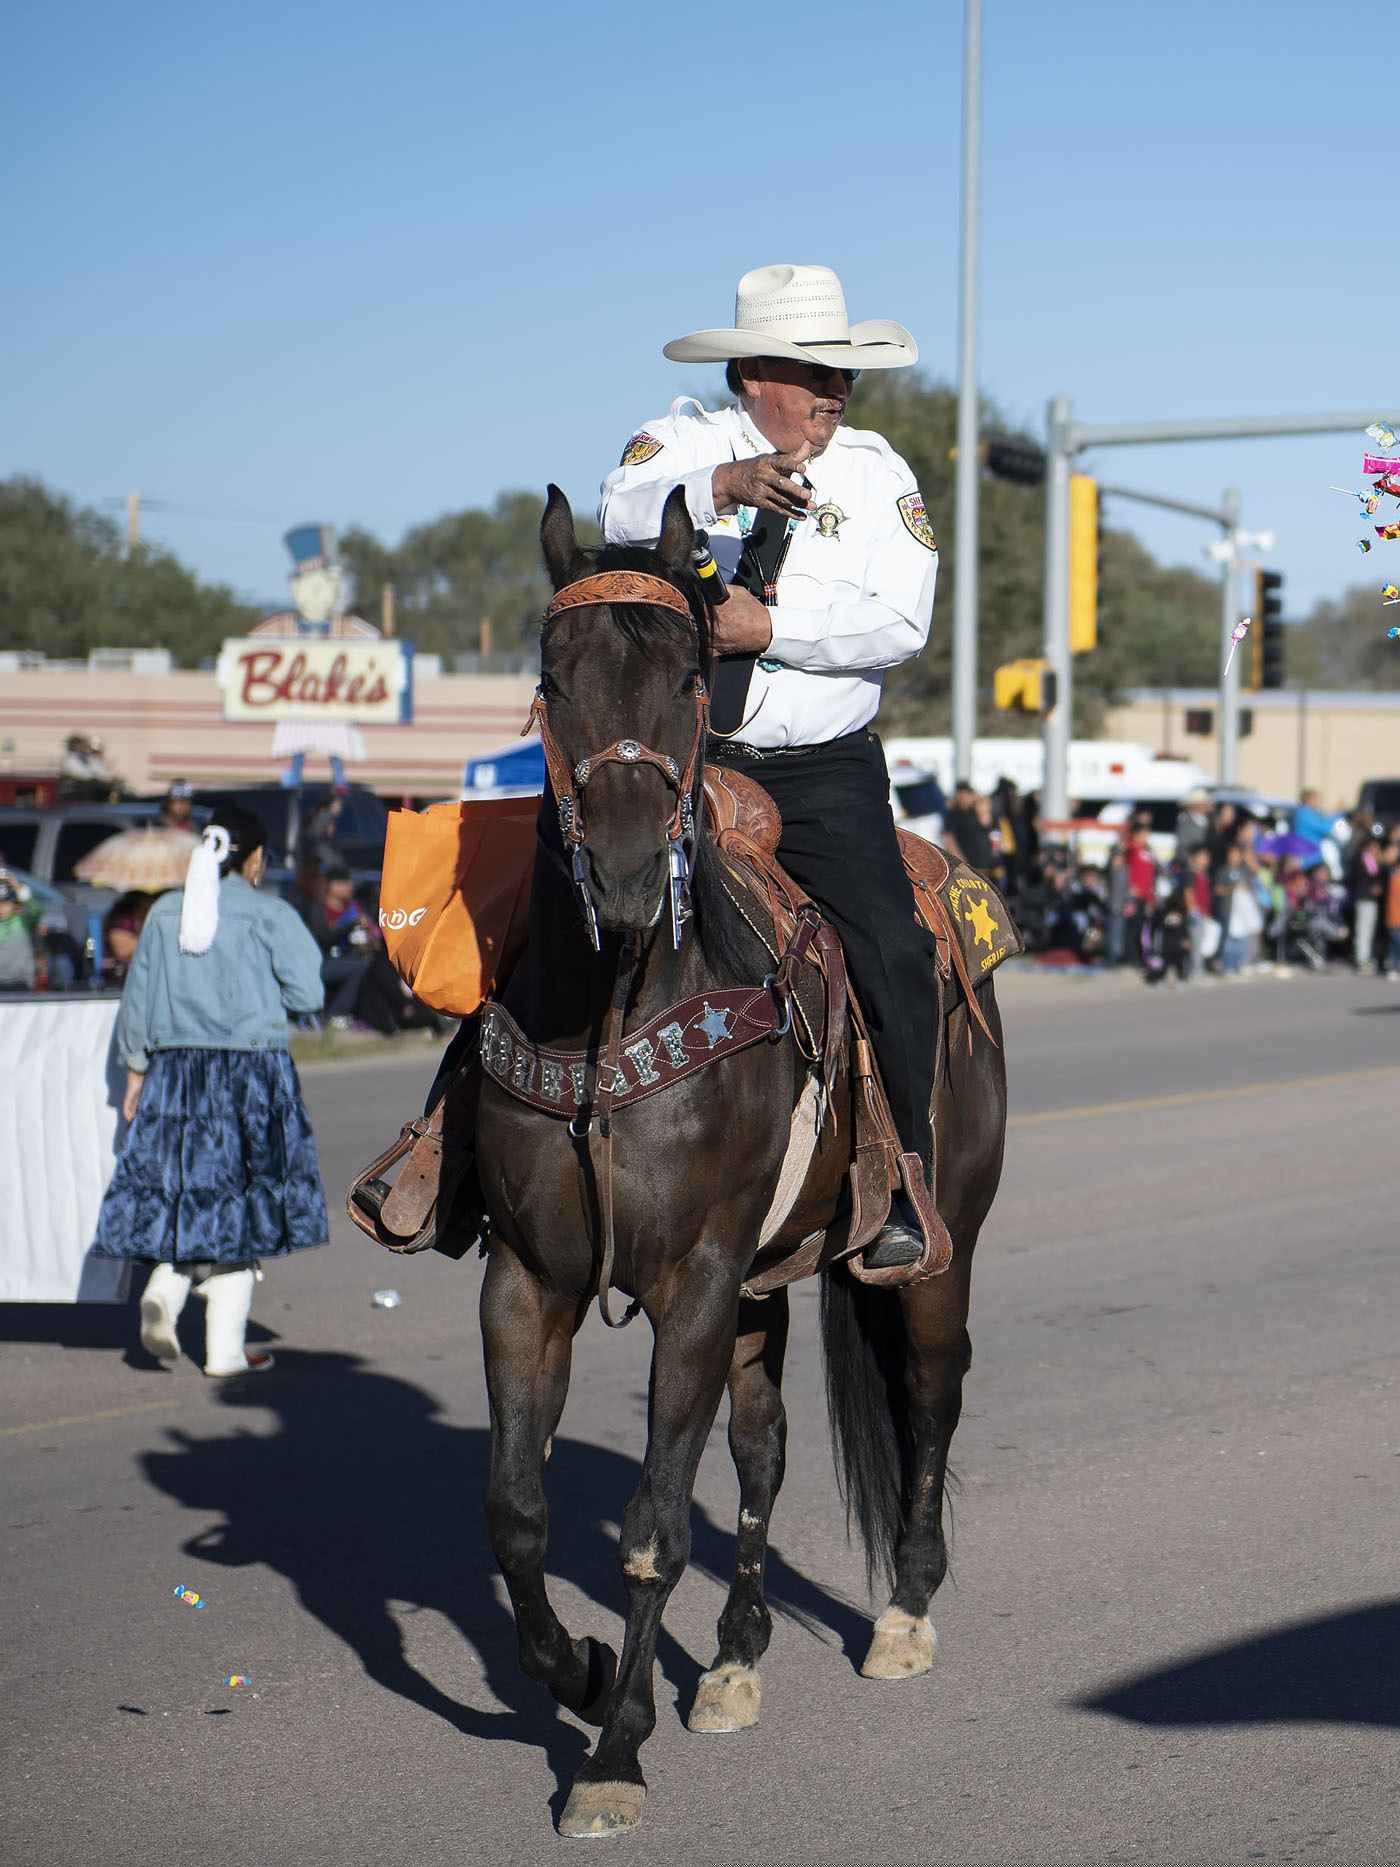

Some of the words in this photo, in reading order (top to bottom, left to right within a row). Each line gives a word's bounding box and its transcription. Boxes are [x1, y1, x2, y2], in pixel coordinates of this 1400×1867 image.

[238, 651, 389, 707] Blake's
[949, 885, 962, 923] APACHE
[956, 878, 988, 891] COUNTY
